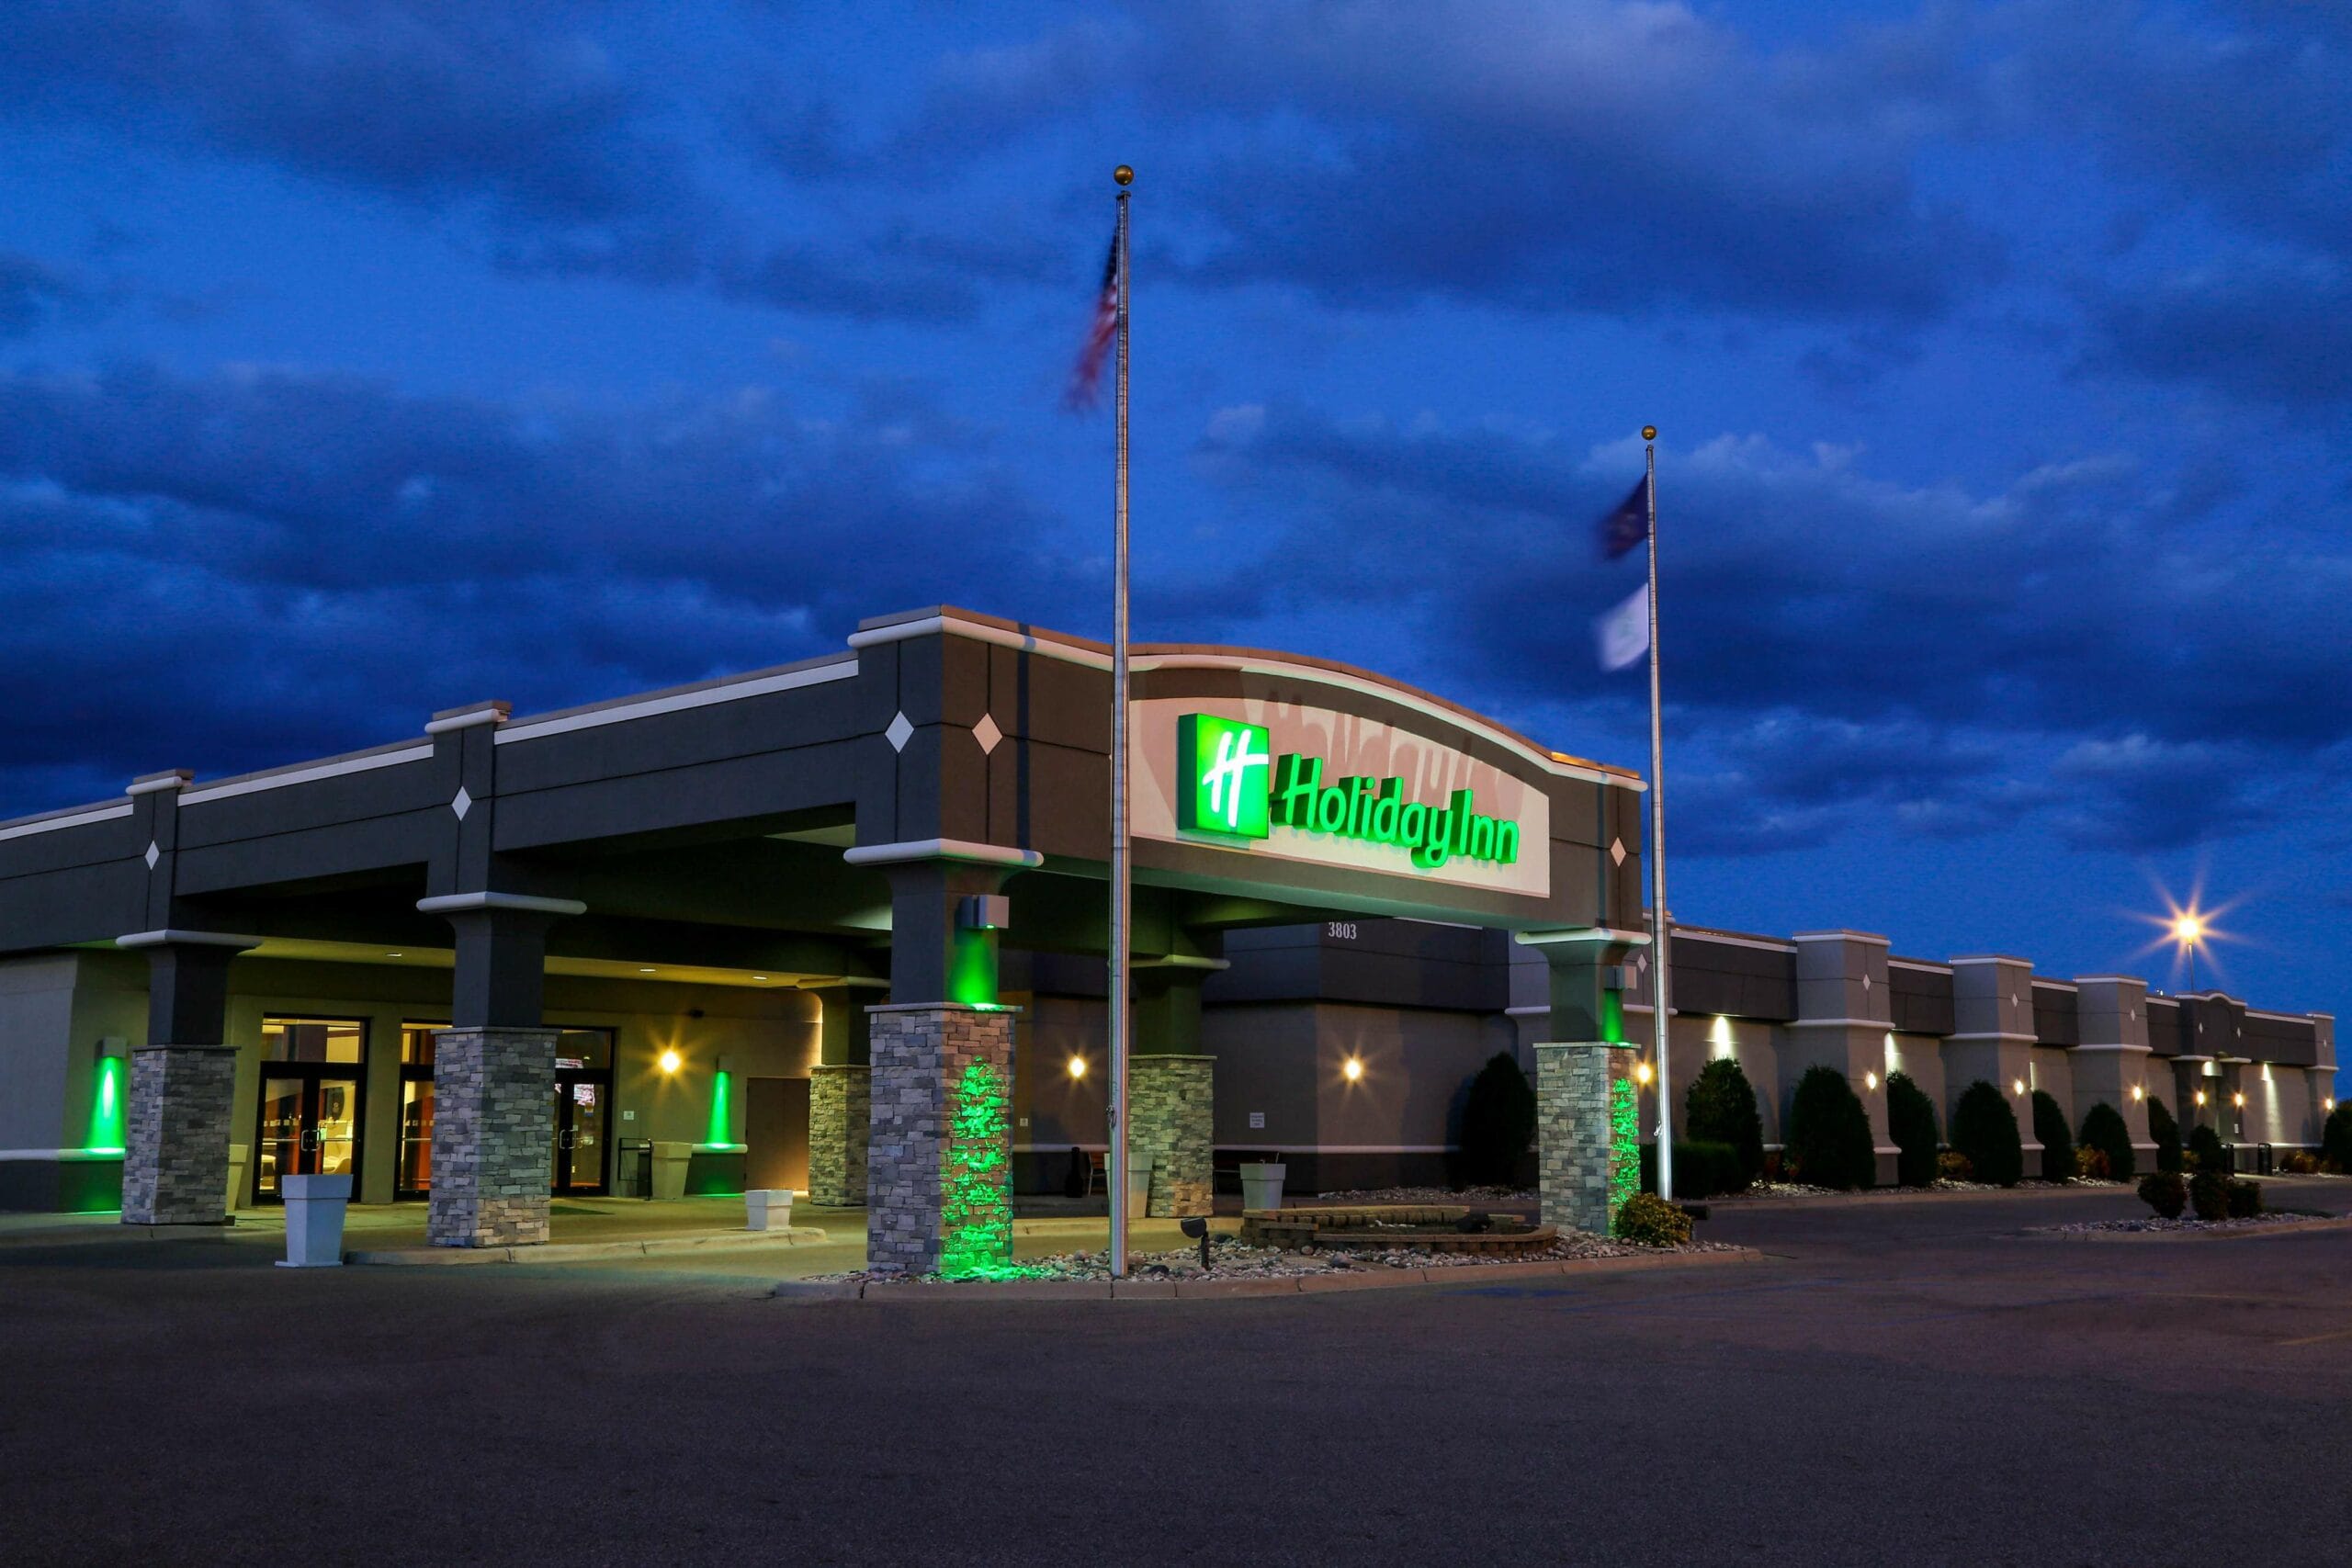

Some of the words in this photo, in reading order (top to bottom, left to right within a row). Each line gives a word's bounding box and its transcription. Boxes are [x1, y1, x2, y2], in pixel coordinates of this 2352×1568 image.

[1273, 753, 1453, 867] Holiday
[1453, 789, 1520, 863] Inn
[1328, 921, 1357, 940] 3803
